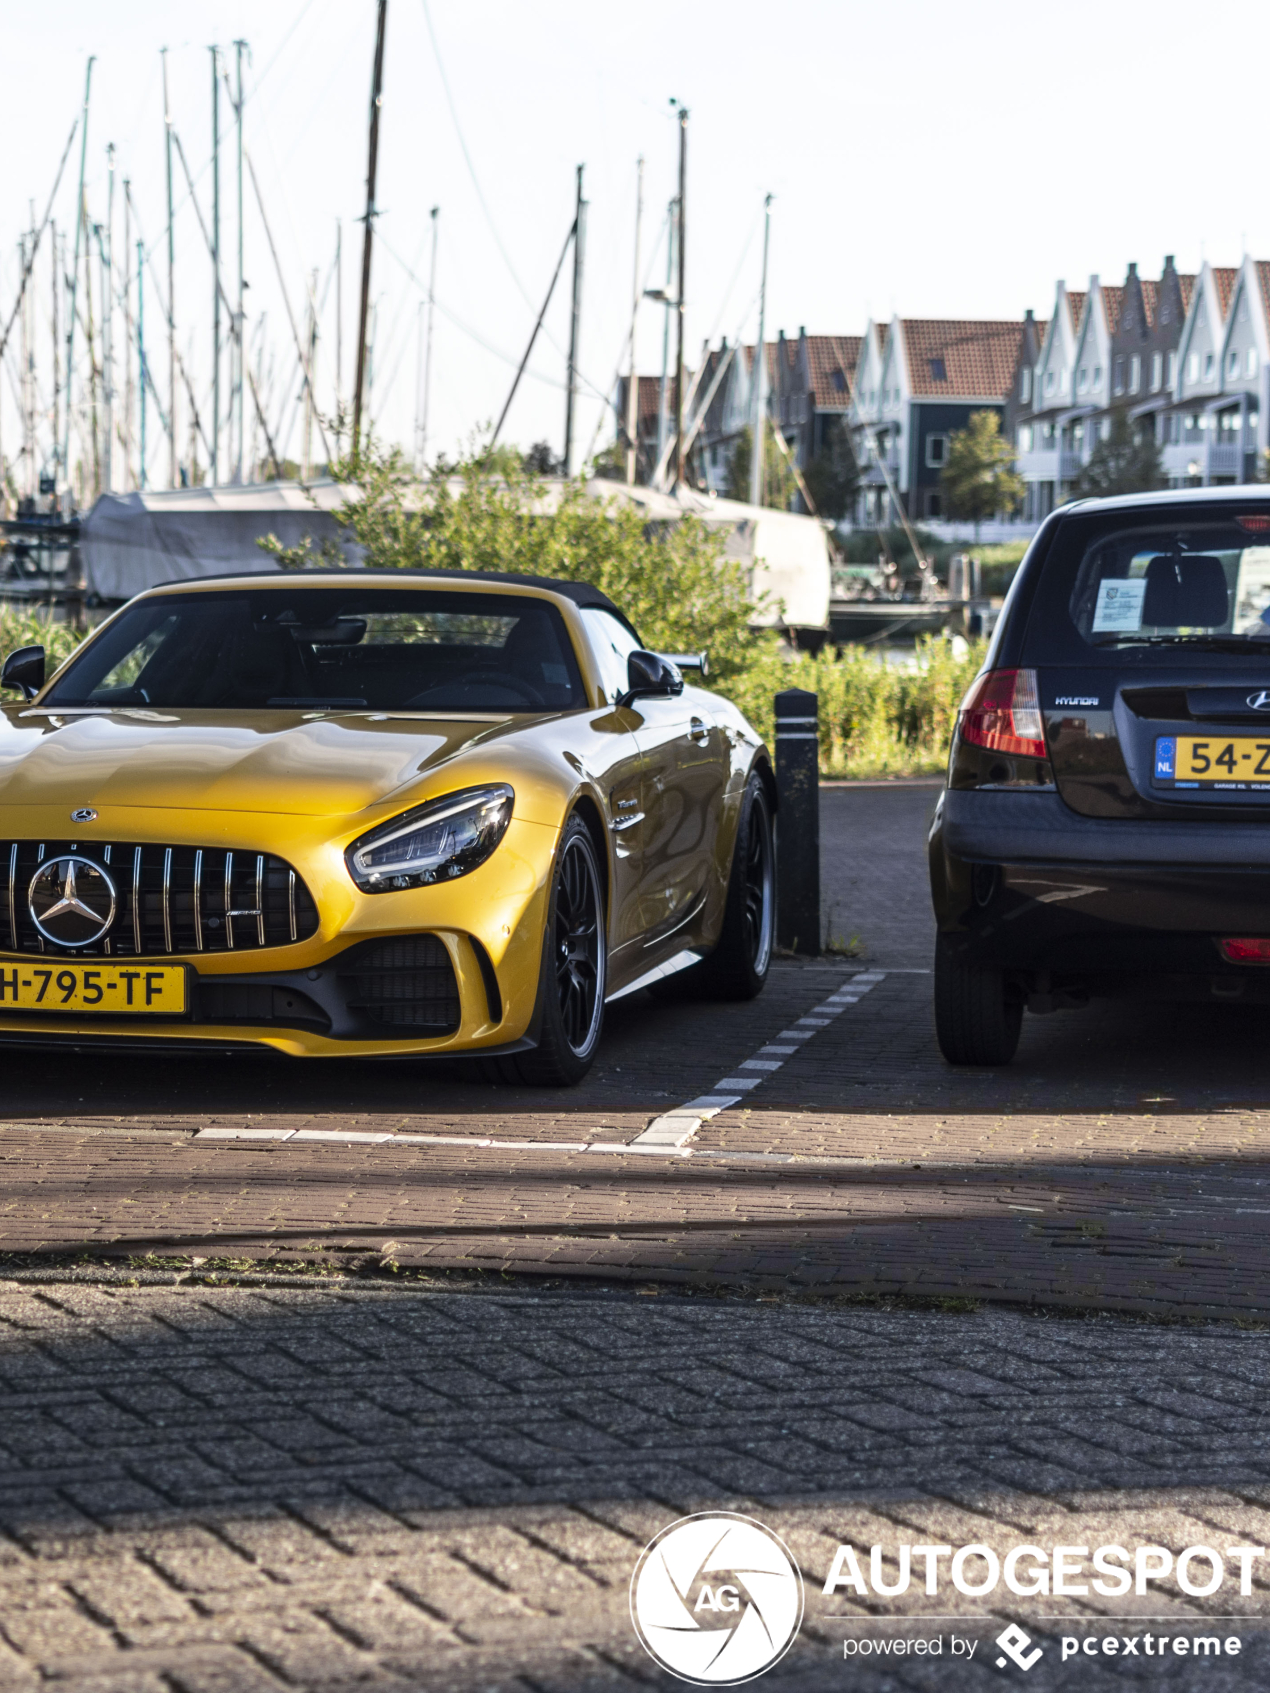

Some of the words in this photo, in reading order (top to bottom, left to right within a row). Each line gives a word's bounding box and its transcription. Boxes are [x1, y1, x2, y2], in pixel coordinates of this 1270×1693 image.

[1055, 696, 1099, 705] HYUNDAI
[1190, 743, 1270, 775] 54-Z
[1157, 762, 1173, 772] NL
